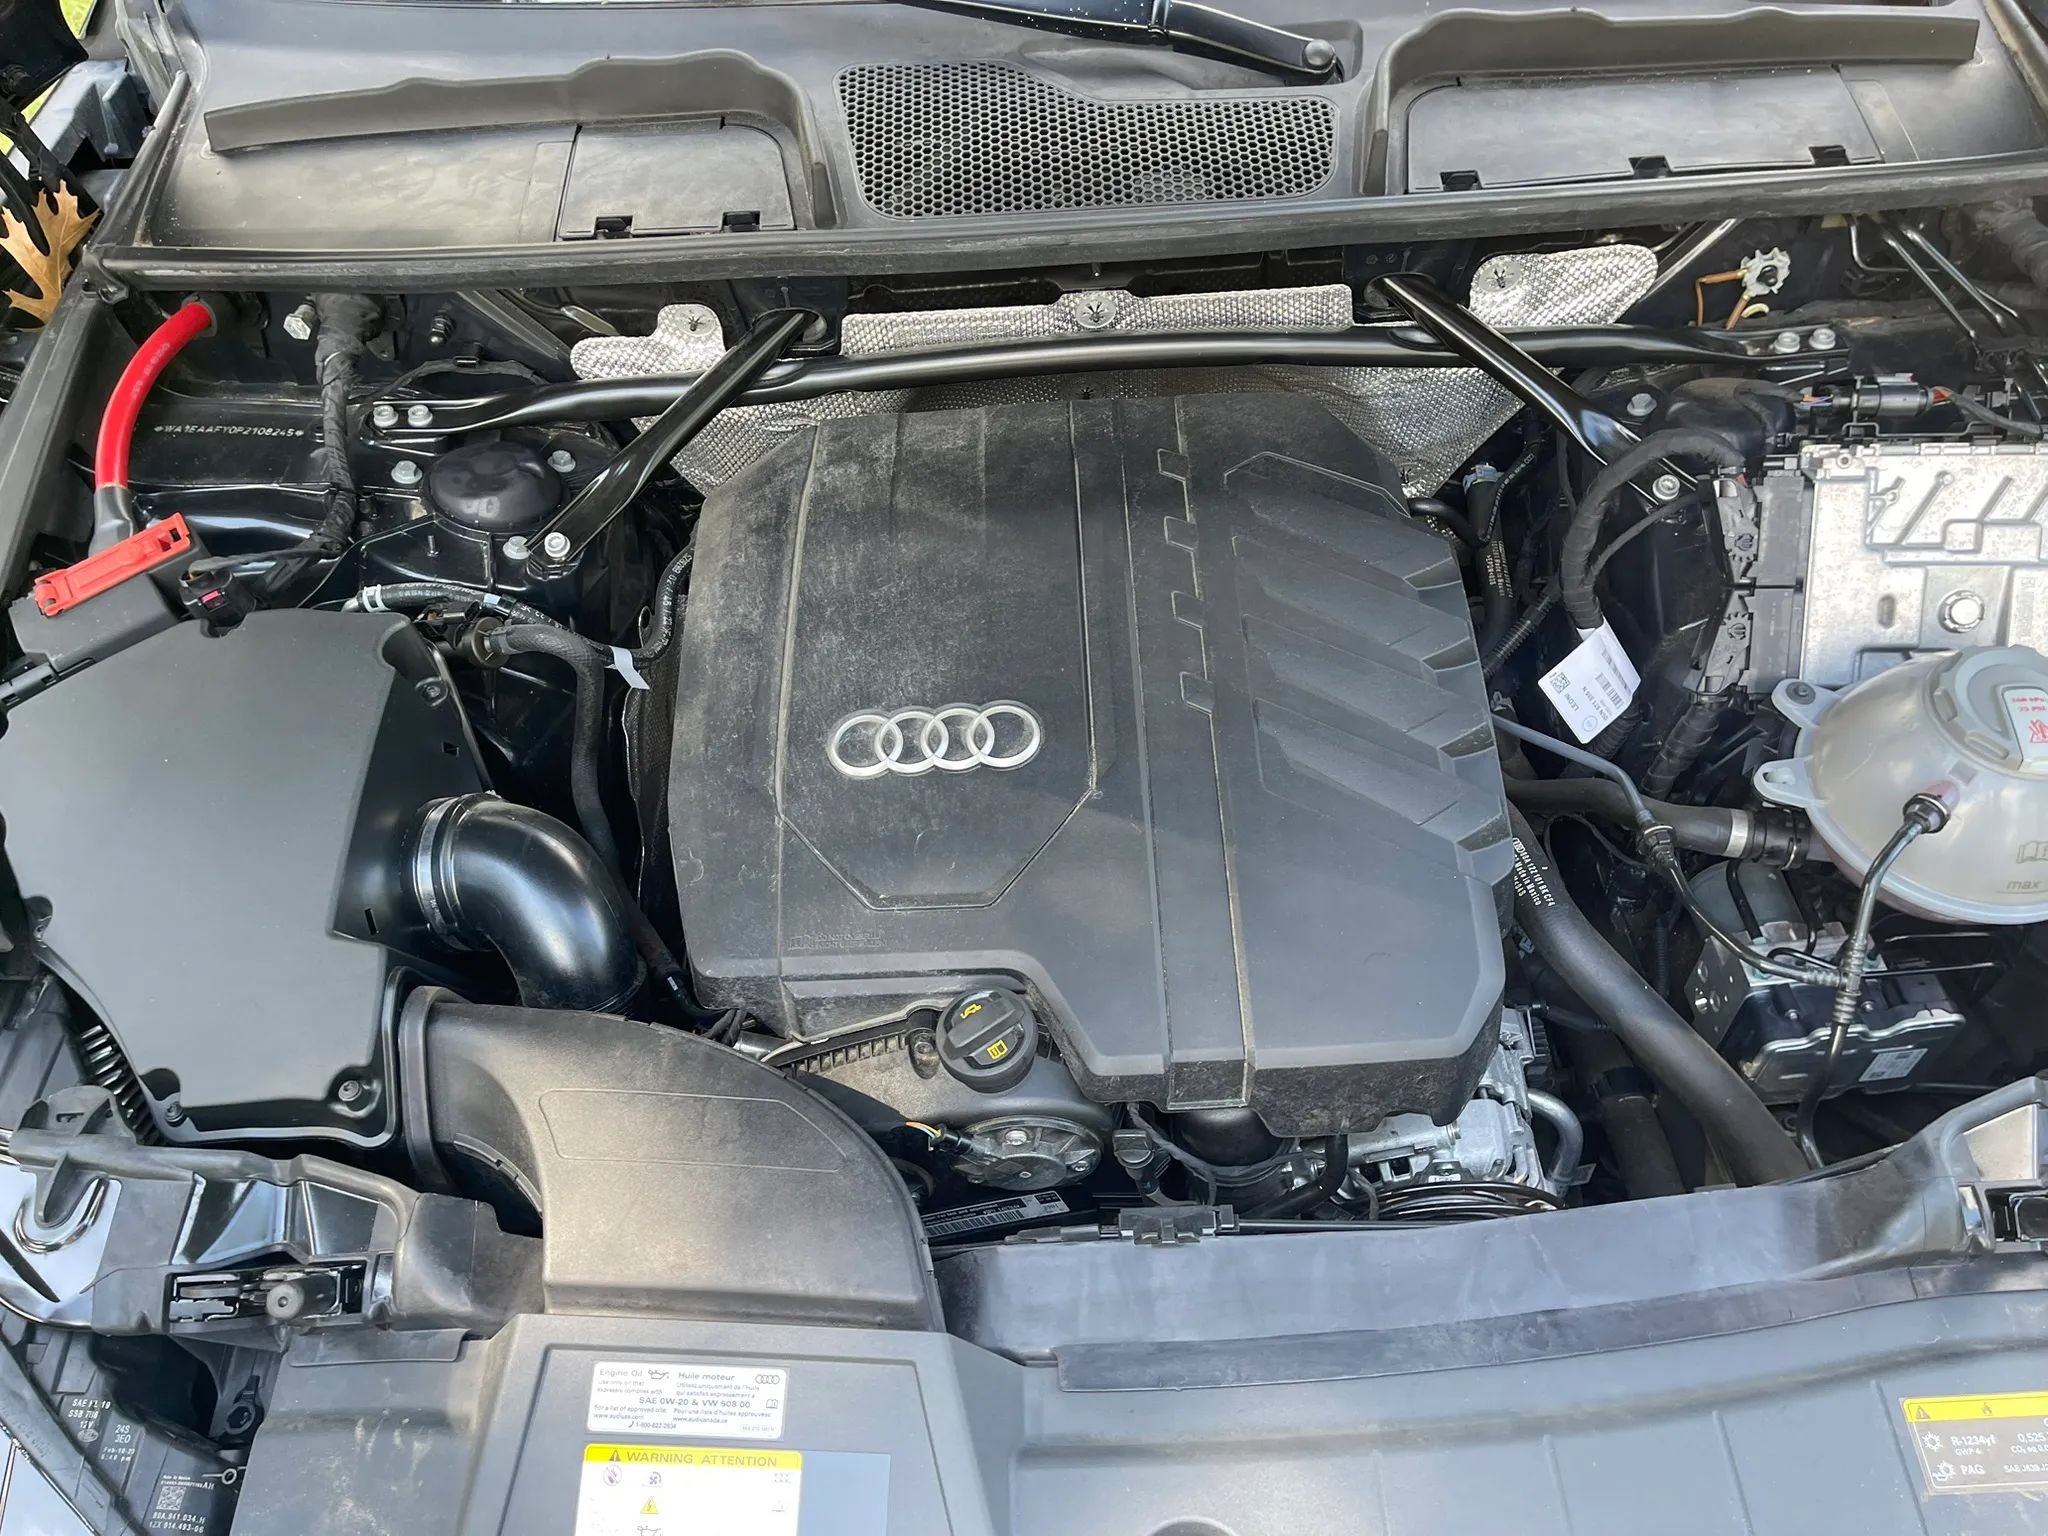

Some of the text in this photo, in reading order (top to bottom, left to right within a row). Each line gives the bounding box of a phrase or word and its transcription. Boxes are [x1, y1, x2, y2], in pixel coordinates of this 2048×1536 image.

[599, 1368, 628, 1377] Engine
[678, 1372, 700, 1380] Huile
[72, 1399, 87, 1407] SAE
[101, 1401, 111, 1409] 19
[702, 1399, 718, 1407] VW
[626, 1451, 777, 1467] WARNING ATTENTION
[1960, 1464, 1986, 1475] PAG
